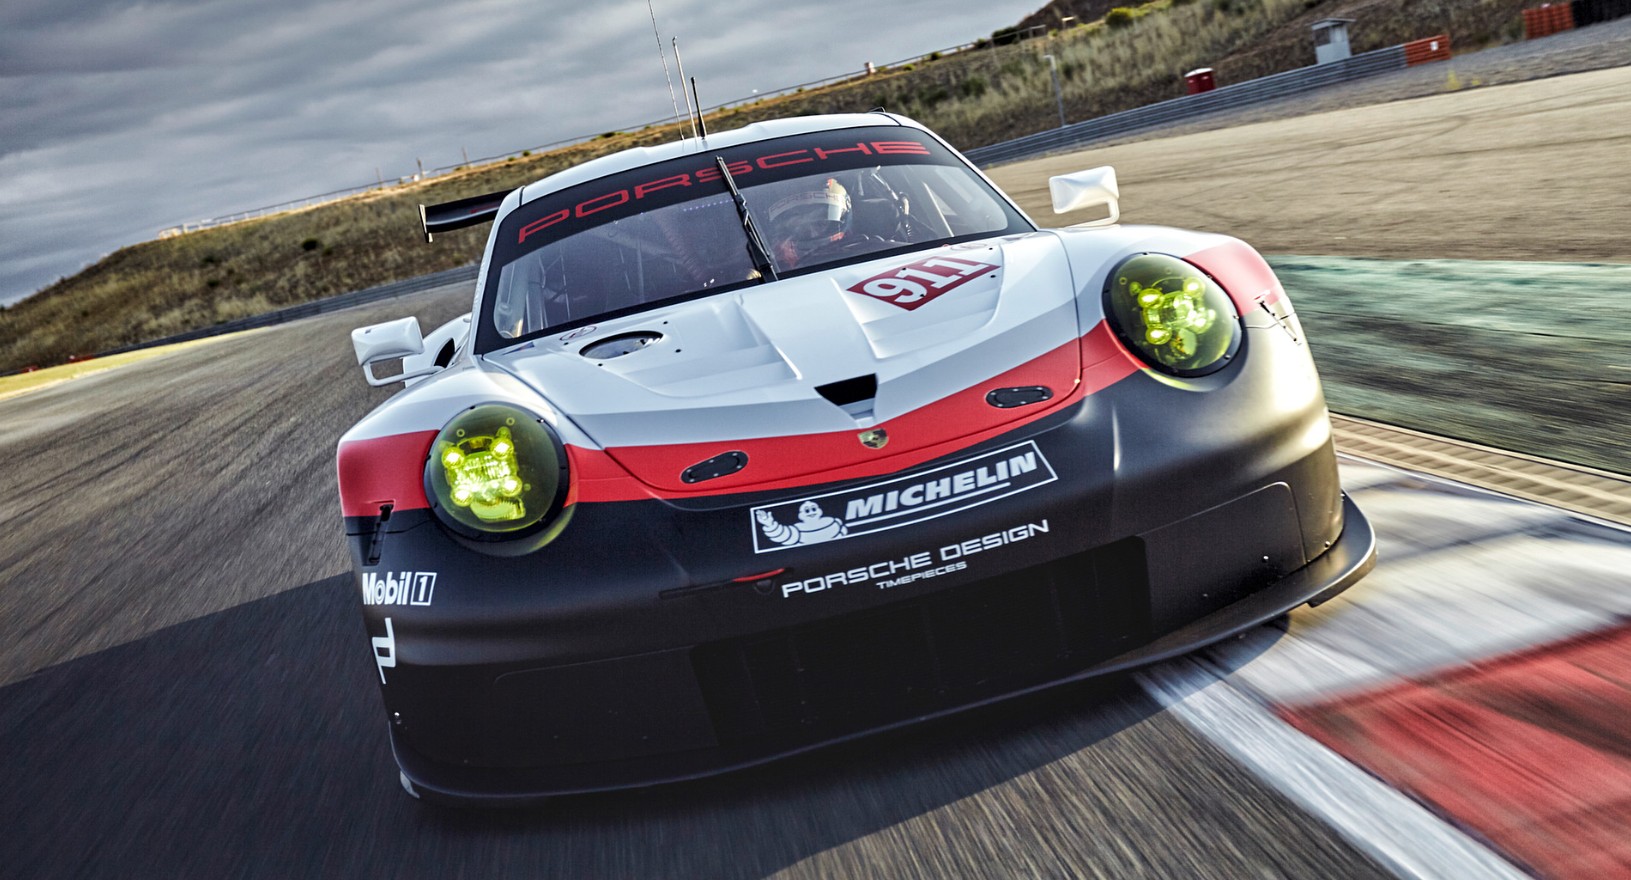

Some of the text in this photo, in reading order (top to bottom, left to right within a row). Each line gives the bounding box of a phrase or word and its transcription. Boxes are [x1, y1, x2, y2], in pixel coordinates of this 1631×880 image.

[517, 140, 931, 244] PORSCHE
[863, 259, 990, 303] 911
[845, 451, 1038, 520] MICHELIN
[781, 519, 1050, 598] PORSCHE DESIGN
[876, 561, 968, 590] TIMEPIECES
[362, 571, 412, 605] Mobil
